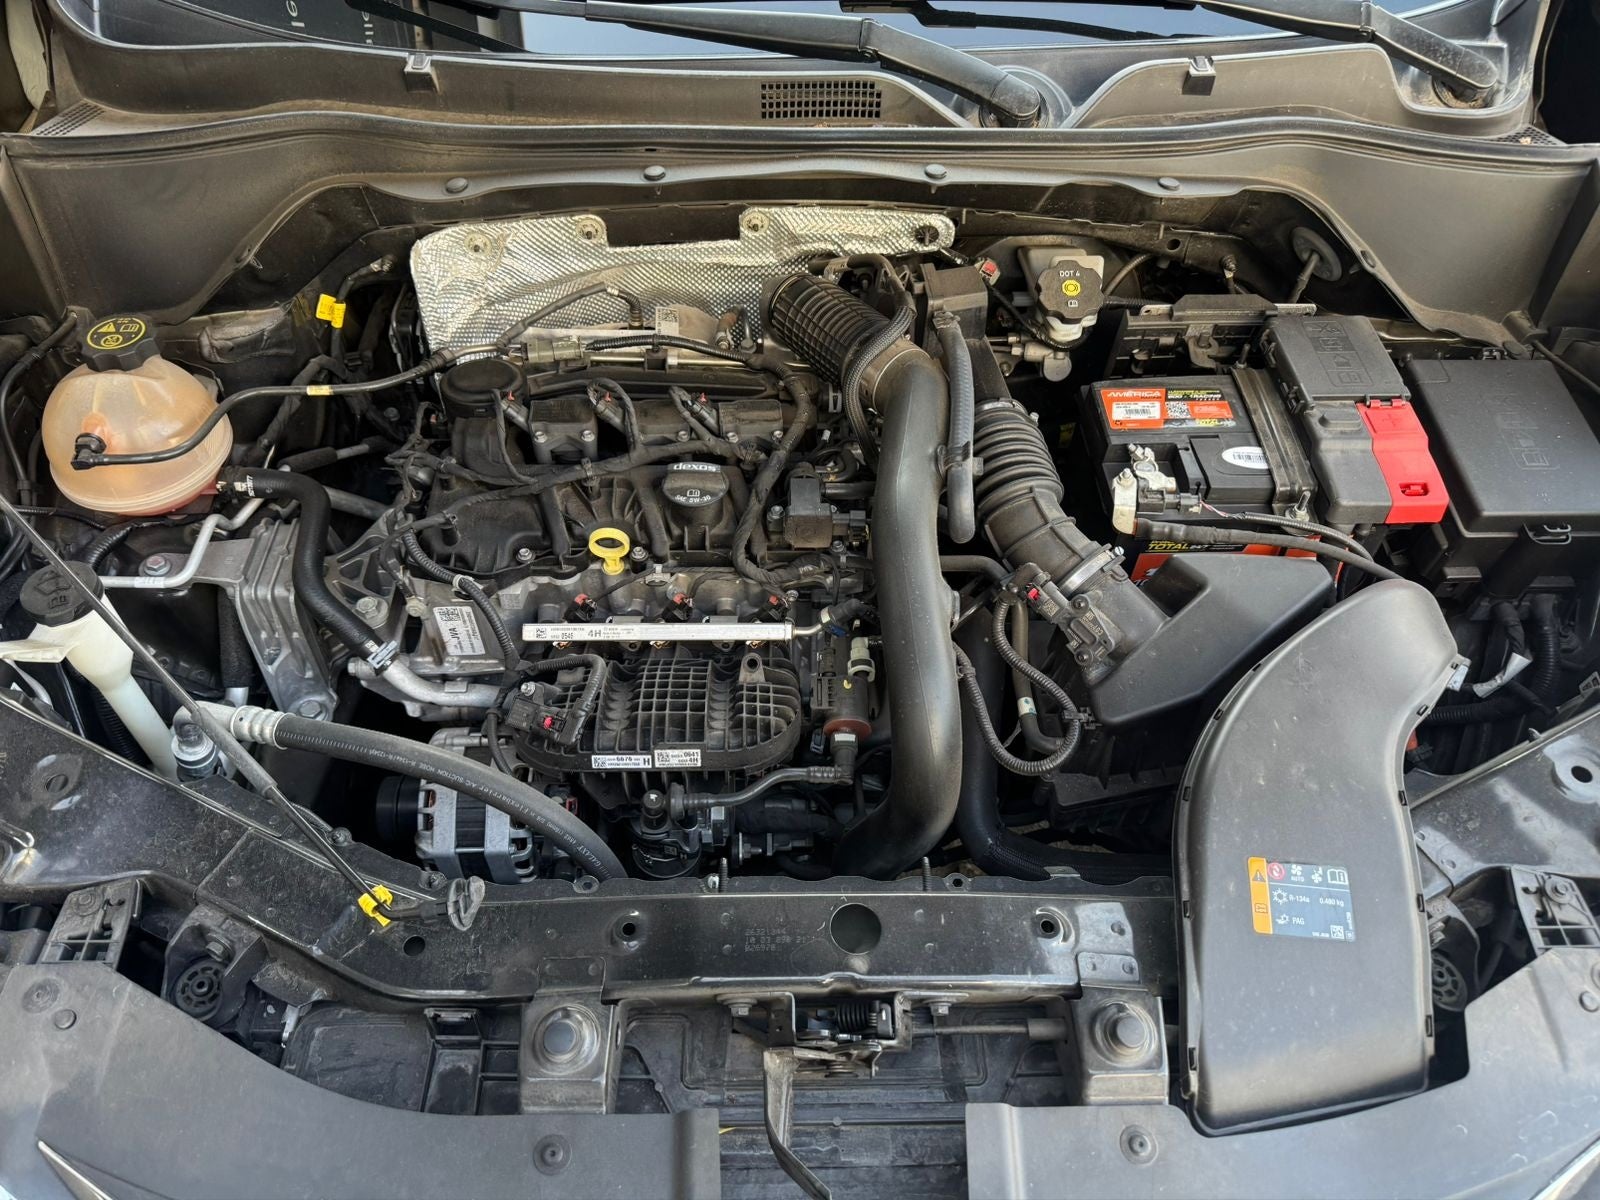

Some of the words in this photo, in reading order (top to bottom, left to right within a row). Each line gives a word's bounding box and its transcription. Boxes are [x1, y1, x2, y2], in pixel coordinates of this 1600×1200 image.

[673, 462, 716, 472] dexos
[643, 757, 651, 766] H
[1288, 894, 1310, 903] R-134a
[1292, 917, 1305, 925] PAG
